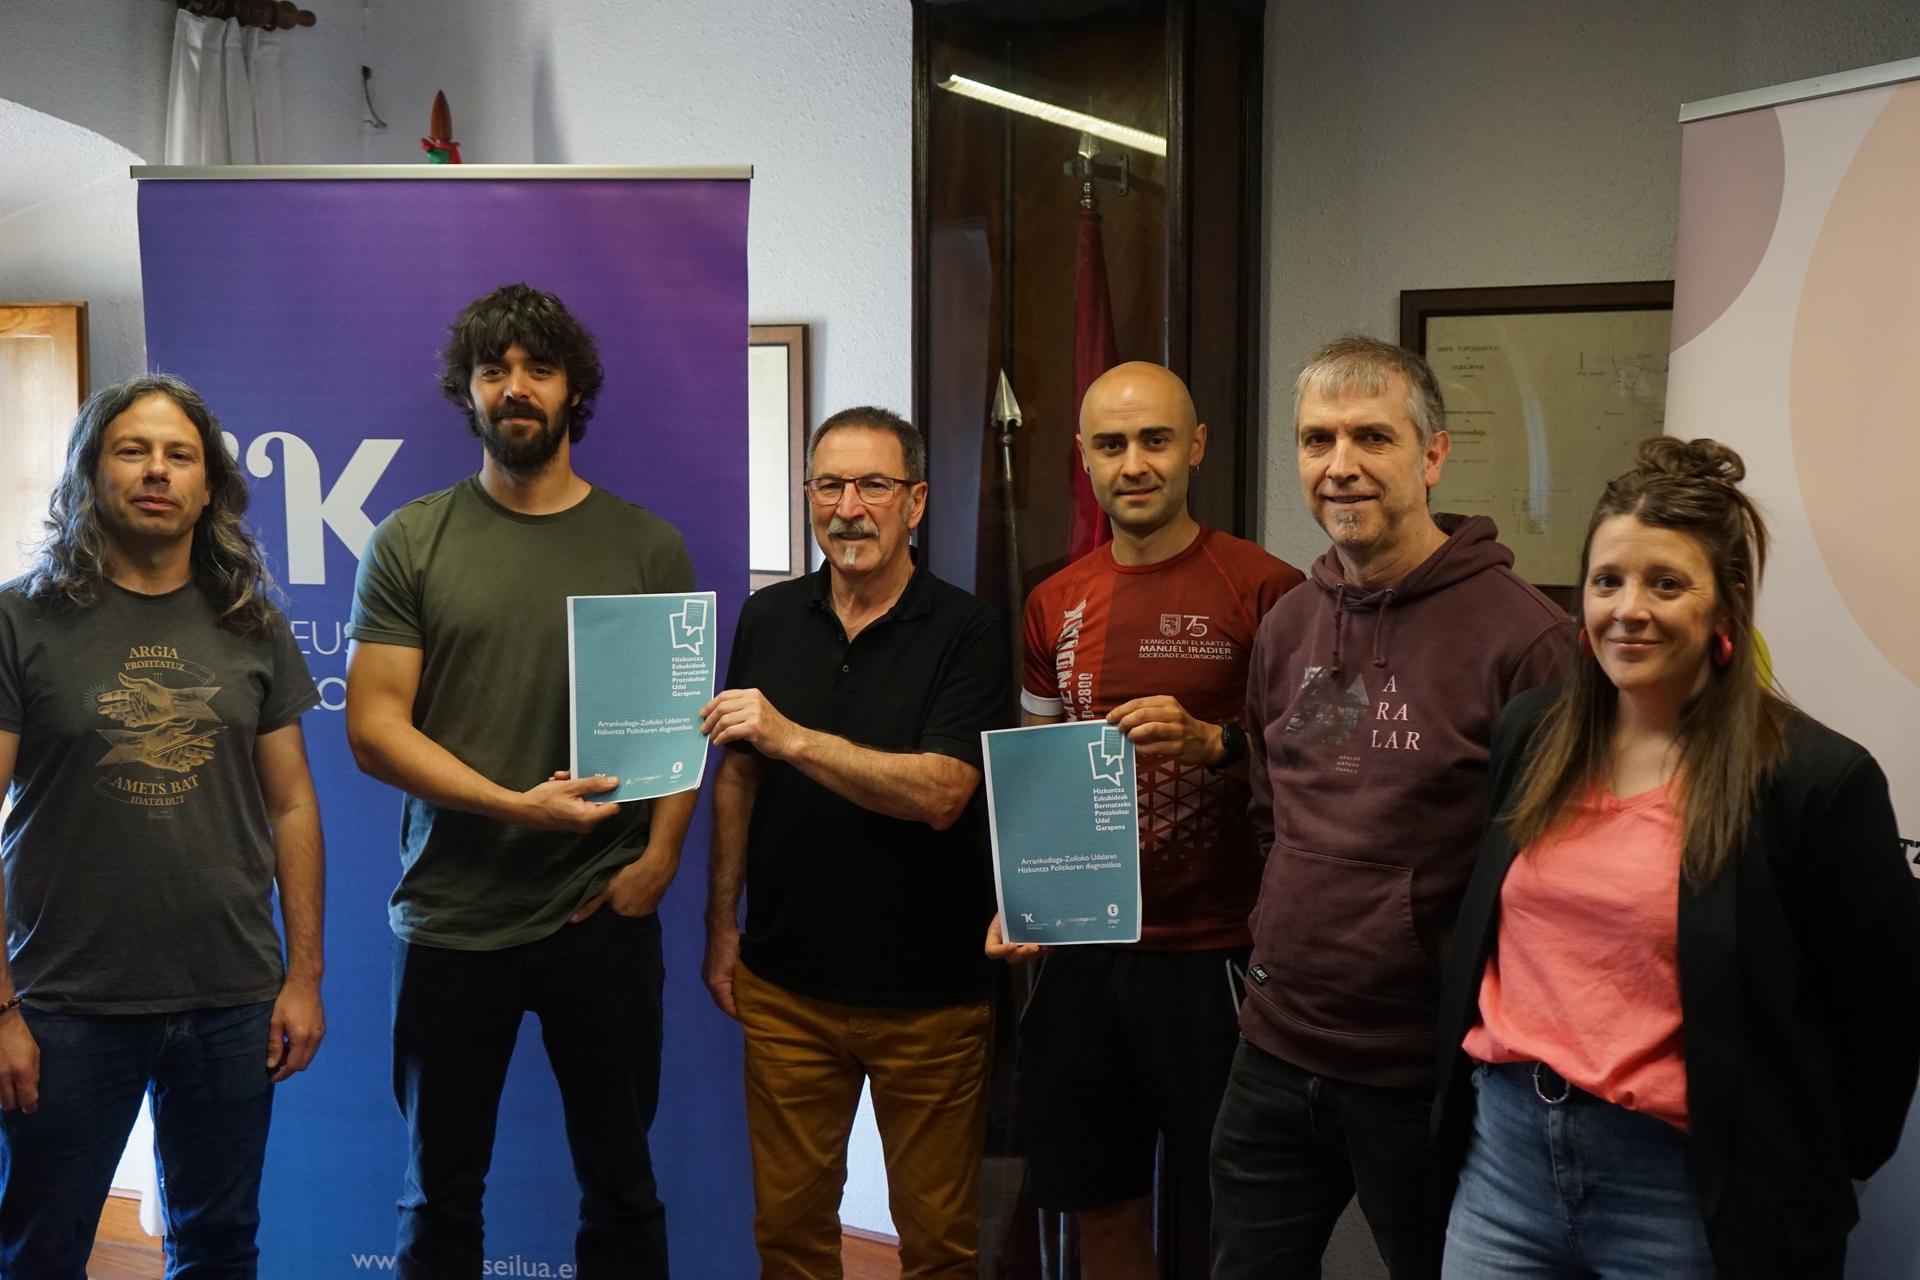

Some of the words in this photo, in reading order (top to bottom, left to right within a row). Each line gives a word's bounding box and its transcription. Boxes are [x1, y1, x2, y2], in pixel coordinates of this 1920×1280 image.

[1183, 615, 1209, 637] 75
[1140, 638, 1189, 646] TXANGOLARI
[129, 645, 179, 659] ARGIA
[1139, 645, 1184, 653] MANUEL
[1188, 646, 1231, 654] IRADIER
[125, 660, 185, 672] PROFITATUZ
[672, 662, 706, 670] Eskubideak
[672, 669, 709, 677] Bermatzeko
[1382, 674, 1398, 693] A
[1376, 702, 1409, 721] RA
[593, 728, 625, 736] Hizkuntza
[626, 727, 658, 735] Politikaren
[1371, 730, 1421, 751] LAR
[111, 776, 167, 795] AMETS
[170, 774, 199, 793] BAT
[1093, 794, 1128, 802] Eskubideak
[1096, 824, 1126, 832] Garapena
[1090, 853, 1117, 861] Udalaren
[1018, 866, 1049, 874] Hizkuntza
[1050, 864, 1084, 872] Politikaren
